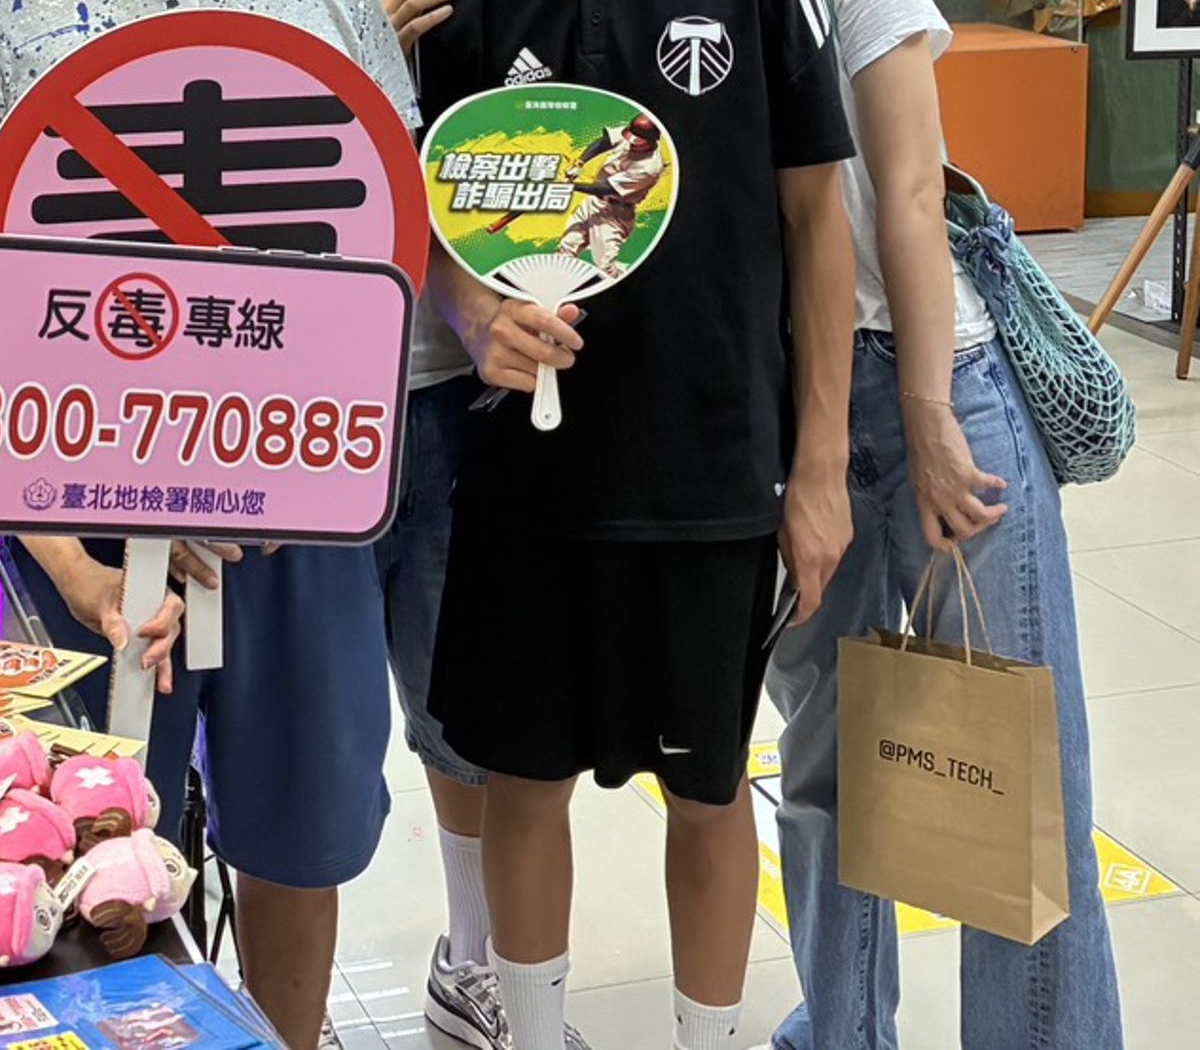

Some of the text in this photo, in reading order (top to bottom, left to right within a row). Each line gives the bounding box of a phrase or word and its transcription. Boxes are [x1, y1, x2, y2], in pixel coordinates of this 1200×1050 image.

[504, 66, 553, 87] adidas
[439, 152, 562, 183] 檢察出擊
[452, 182, 575, 212] 詐騙出局
[37, 287, 287, 351] 反毒專線
[60, 480, 267, 516] 臺北地檢署關心您
[878, 738, 1005, 796] @PMS_TECH_
